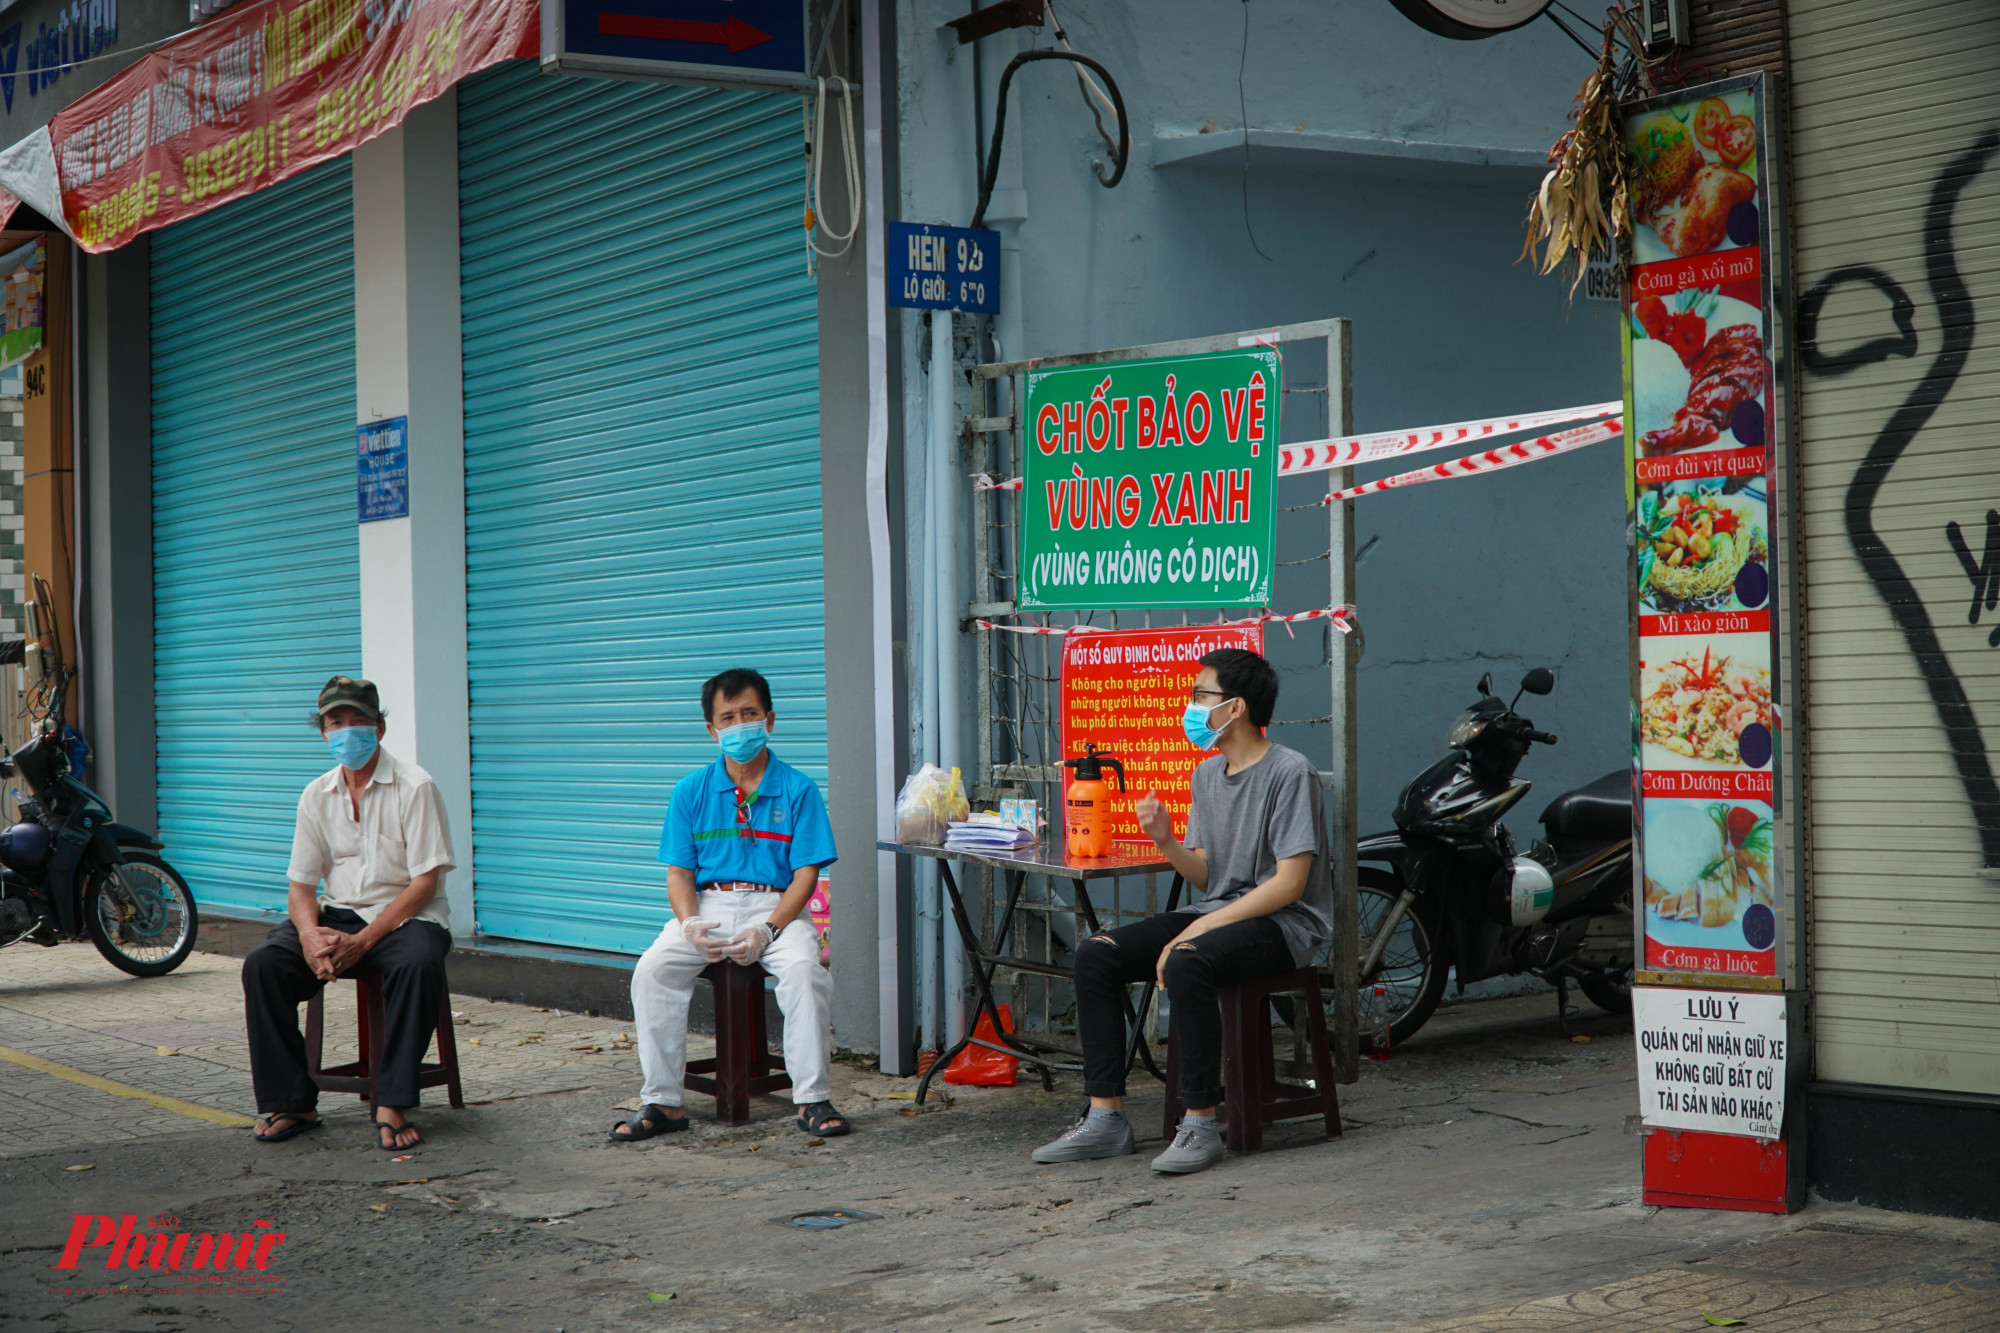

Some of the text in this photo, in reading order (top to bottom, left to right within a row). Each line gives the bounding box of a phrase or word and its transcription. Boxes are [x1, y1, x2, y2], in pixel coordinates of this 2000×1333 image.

[908, 225, 946, 272] HẺM
[1637, 256, 1753, 290] Cơm gà xối mỡ
[904, 272, 919, 303] LỘ
[27, 364, 45, 400] 94C
[1035, 371, 1266, 458] CHỐT BẢO VỆ
[368, 428, 402, 452] viettien
[369, 452, 395, 469] HOUSE
[1636, 454, 1765, 479] Cơm đùi vịt quay
[1045, 462, 1252, 531] VÙNG XANH
[1031, 537, 1259, 596] (VÙNG KHÔNG CÓ DỊCH)
[1658, 612, 1749, 634] Mì xào giòn
[1070, 644, 1088, 671] MỘT
[1089, 640, 1102, 664] SỐ
[1103, 646, 1123, 665] QUY
[1125, 645, 1150, 668] ĐỊNH
[1151, 639, 1175, 663] CỦA
[1177, 635, 1206, 661] CHỐT
[1071, 676, 1102, 693] Không
[1104, 676, 1124, 690] cho
[1126, 674, 1160, 692] người
[1163, 673, 1174, 691] lạ
[1071, 696, 1101, 712] những
[1102, 695, 1132, 711] người
[1133, 694, 1165, 711] không
[1168, 696, 1183, 707] cư
[1071, 715, 1088, 728] khu
[1089, 713, 1107, 731] phố
[1108, 714, 1117, 728] di
[1119, 712, 1154, 731] chuyển
[1155, 713, 1174, 728] vào
[1097, 741, 1111, 752] tra
[1113, 738, 1133, 755] việc
[1135, 737, 1160, 754] chấp
[1161, 737, 1189, 752] hành
[1124, 756, 1158, 772] khuẩn
[1161, 757, 1196, 774] người
[1136, 778, 1147, 790] di
[1149, 775, 1191, 793] chuyển
[1641, 772, 1773, 796] Cơm Dương Châu
[1118, 820, 1138, 834] vào
[1662, 949, 1698, 969] Cơm
[1703, 952, 1721, 971] gà
[1687, 995, 1740, 1020] LƯU Ý
[1641, 1026, 1785, 1060] QUÁN CHỈ NHẬN GIỮ XE
[1655, 1058, 1774, 1090] KHÔNG GIỮ BẤT CỨ
[1657, 1087, 1773, 1121] TÀI SẢN NÀO KHÁC
